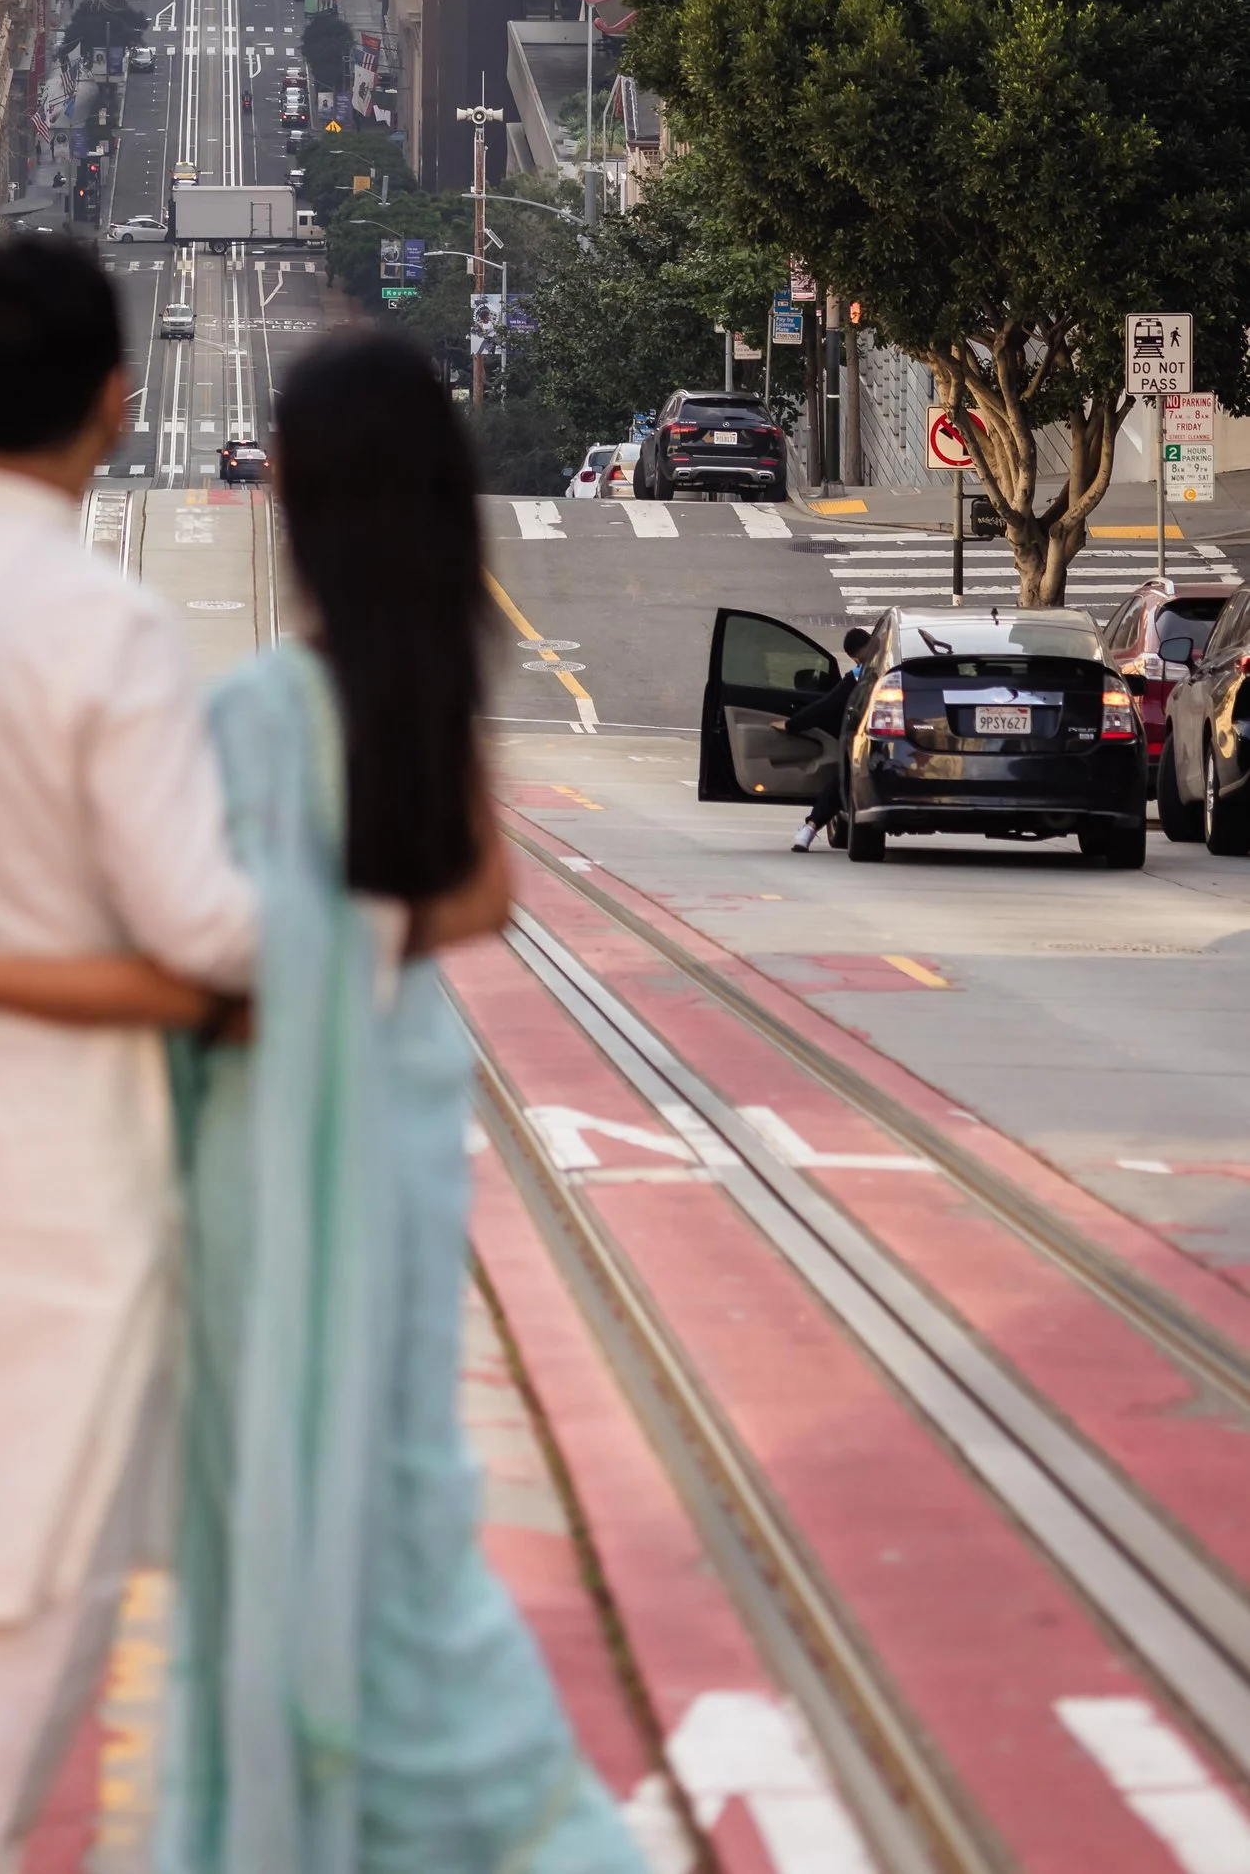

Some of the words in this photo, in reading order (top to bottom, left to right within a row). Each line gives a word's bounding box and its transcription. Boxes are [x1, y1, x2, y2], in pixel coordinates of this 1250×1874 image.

[1133, 362, 1151, 374] DO
[1159, 362, 1186, 374] NOT
[1141, 378, 1177, 391] PASS
[1166, 395, 1180, 408] NO
[1182, 398, 1212, 407] PARKING
[1169, 410, 1175, 420] 7
[1195, 410, 1201, 420] 8
[1176, 423, 1202, 431] FRIDAY
[1168, 446, 1178, 460] 2
[1171, 463, 1178, 473] 8
[1193, 463, 1200, 473] 9
[979, 716, 1028, 730] 9PSY627
